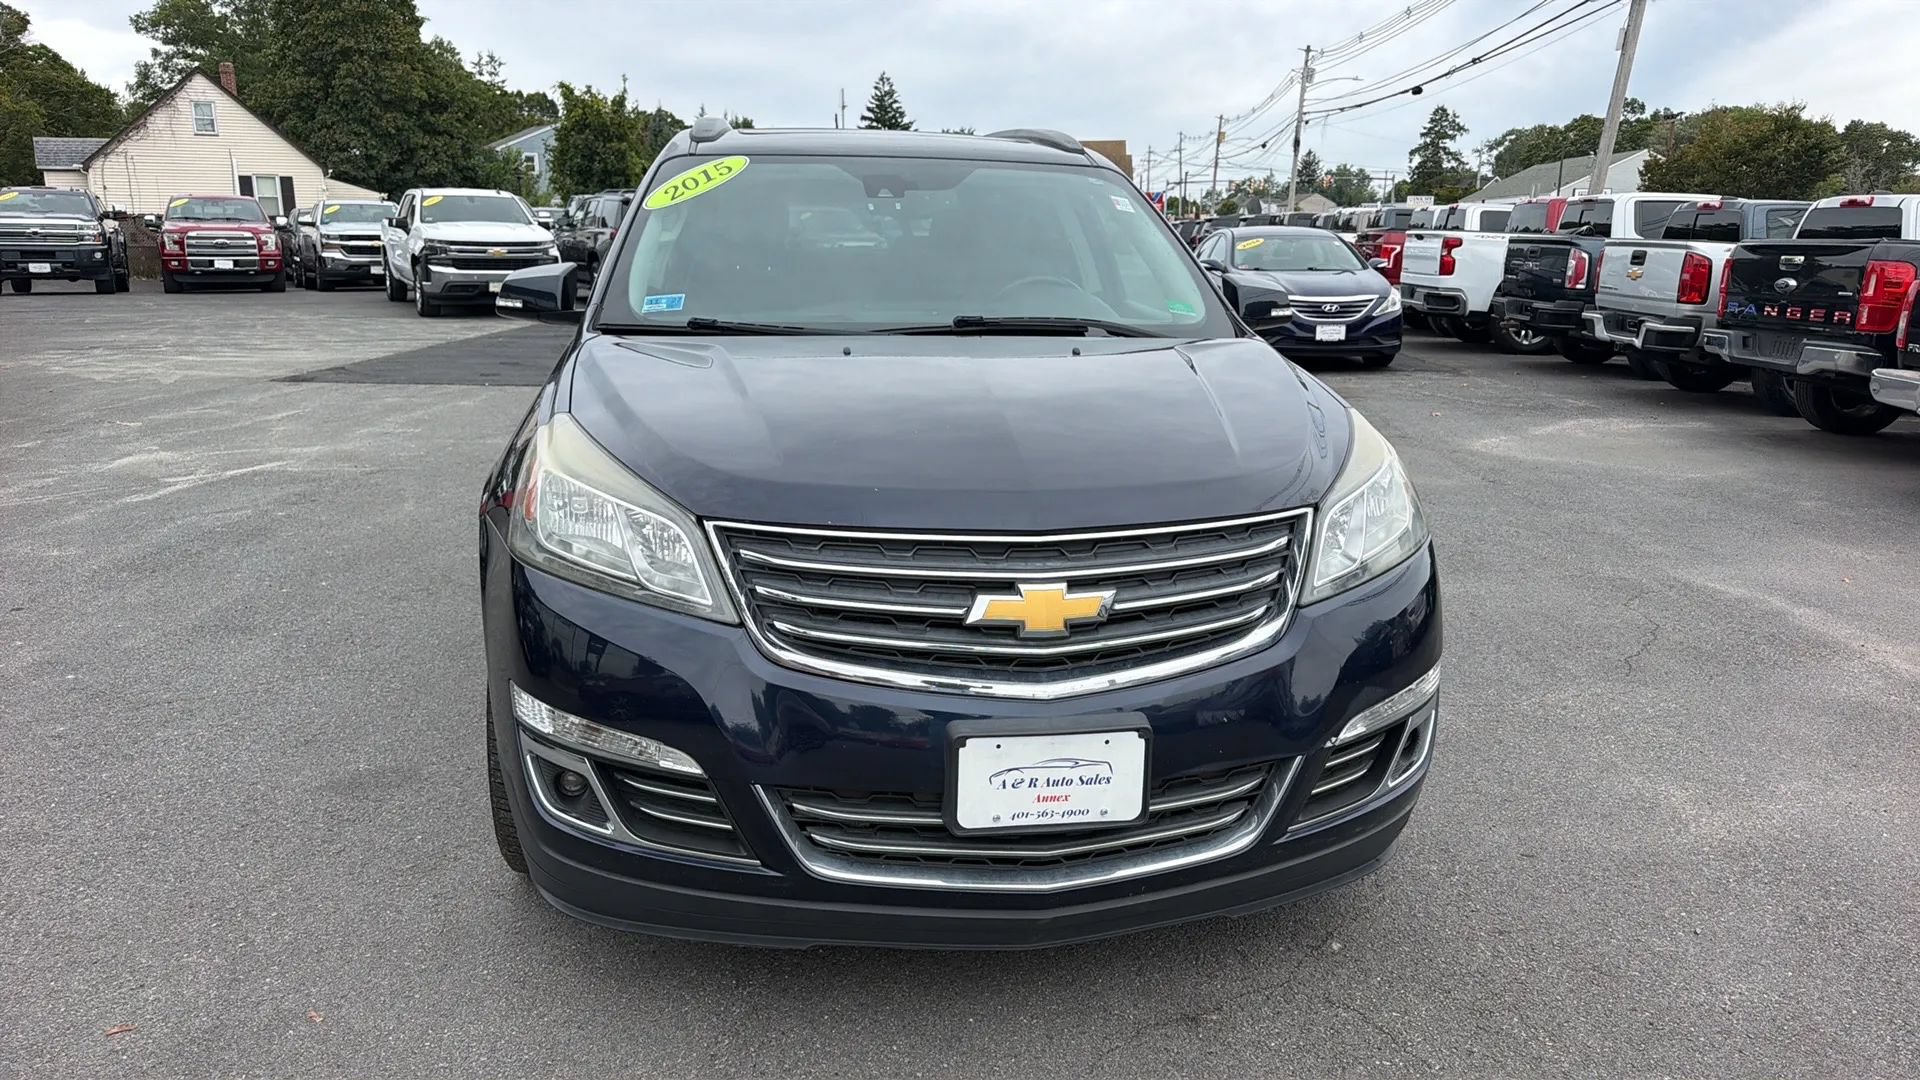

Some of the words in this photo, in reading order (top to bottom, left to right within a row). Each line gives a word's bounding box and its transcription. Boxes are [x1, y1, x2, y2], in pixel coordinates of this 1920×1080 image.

[664, 161, 733, 201] 2015
[1727, 301, 1852, 324] RANGER
[997, 777, 1007, 790] A
[1011, 778, 1024, 789] &
[1028, 777, 1039, 789] R
[1041, 776, 1073, 789] Auto
[1076, 773, 1112, 787] Sales
[1032, 793, 1072, 804] Annex
[1010, 808, 1090, 821] 401-563-4900
